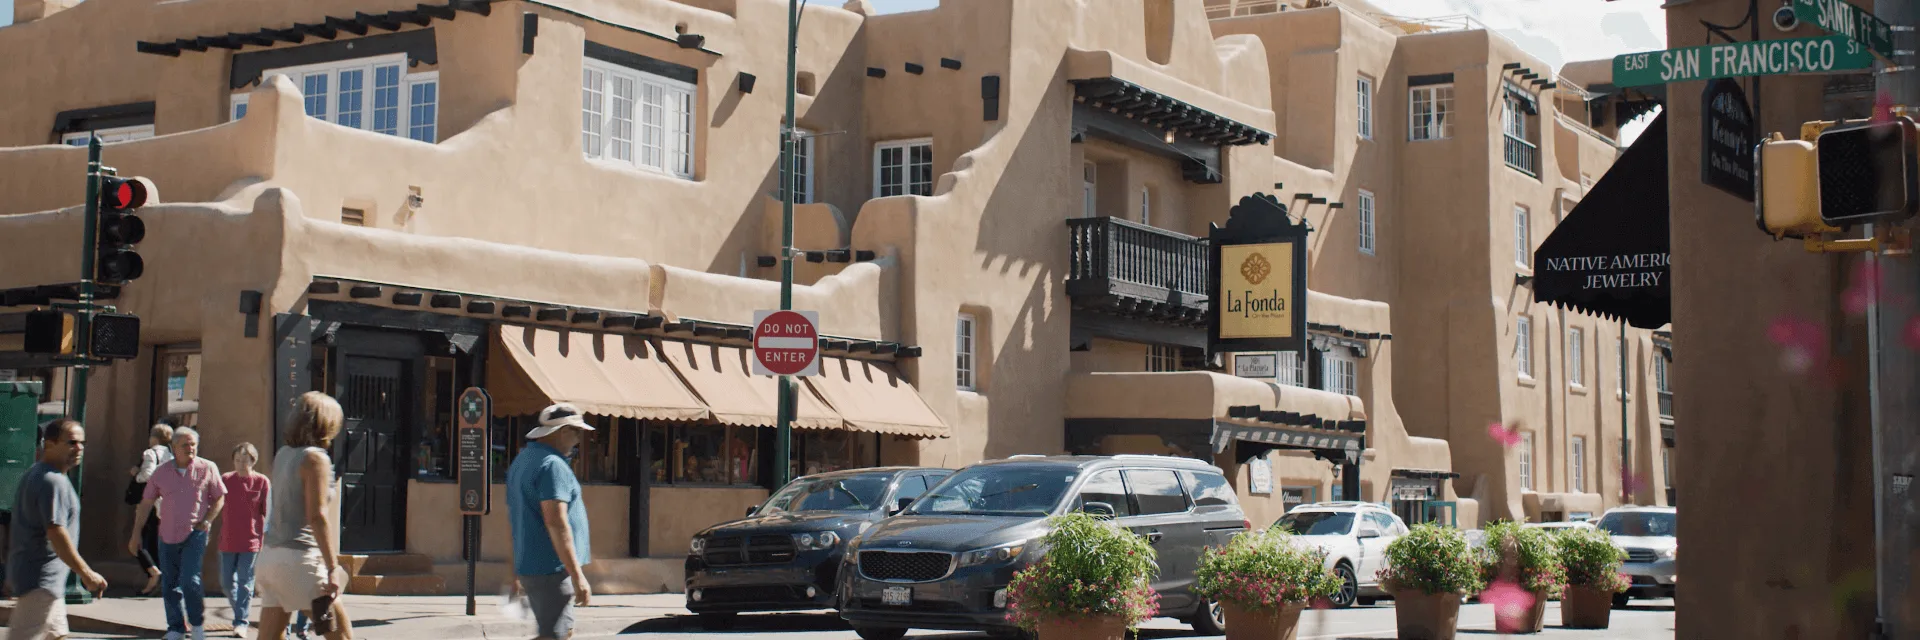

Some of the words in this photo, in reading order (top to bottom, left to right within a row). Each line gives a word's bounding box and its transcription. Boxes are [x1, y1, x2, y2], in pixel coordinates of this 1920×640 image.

[1818, 0, 1857, 40] SANTA
[1624, 55, 1649, 71] EAST
[1660, 48, 1700, 81] SAN
[1711, 39, 1835, 76] FRANCISCO
[1546, 255, 1608, 271] NATIVE
[1582, 271, 1663, 290] JEWELRY
[1227, 289, 1242, 313] La
[1245, 288, 1285, 318] Fonda
[764, 323, 780, 334] DO
[785, 323, 809, 334] NOT
[765, 351, 806, 363] ENTER
